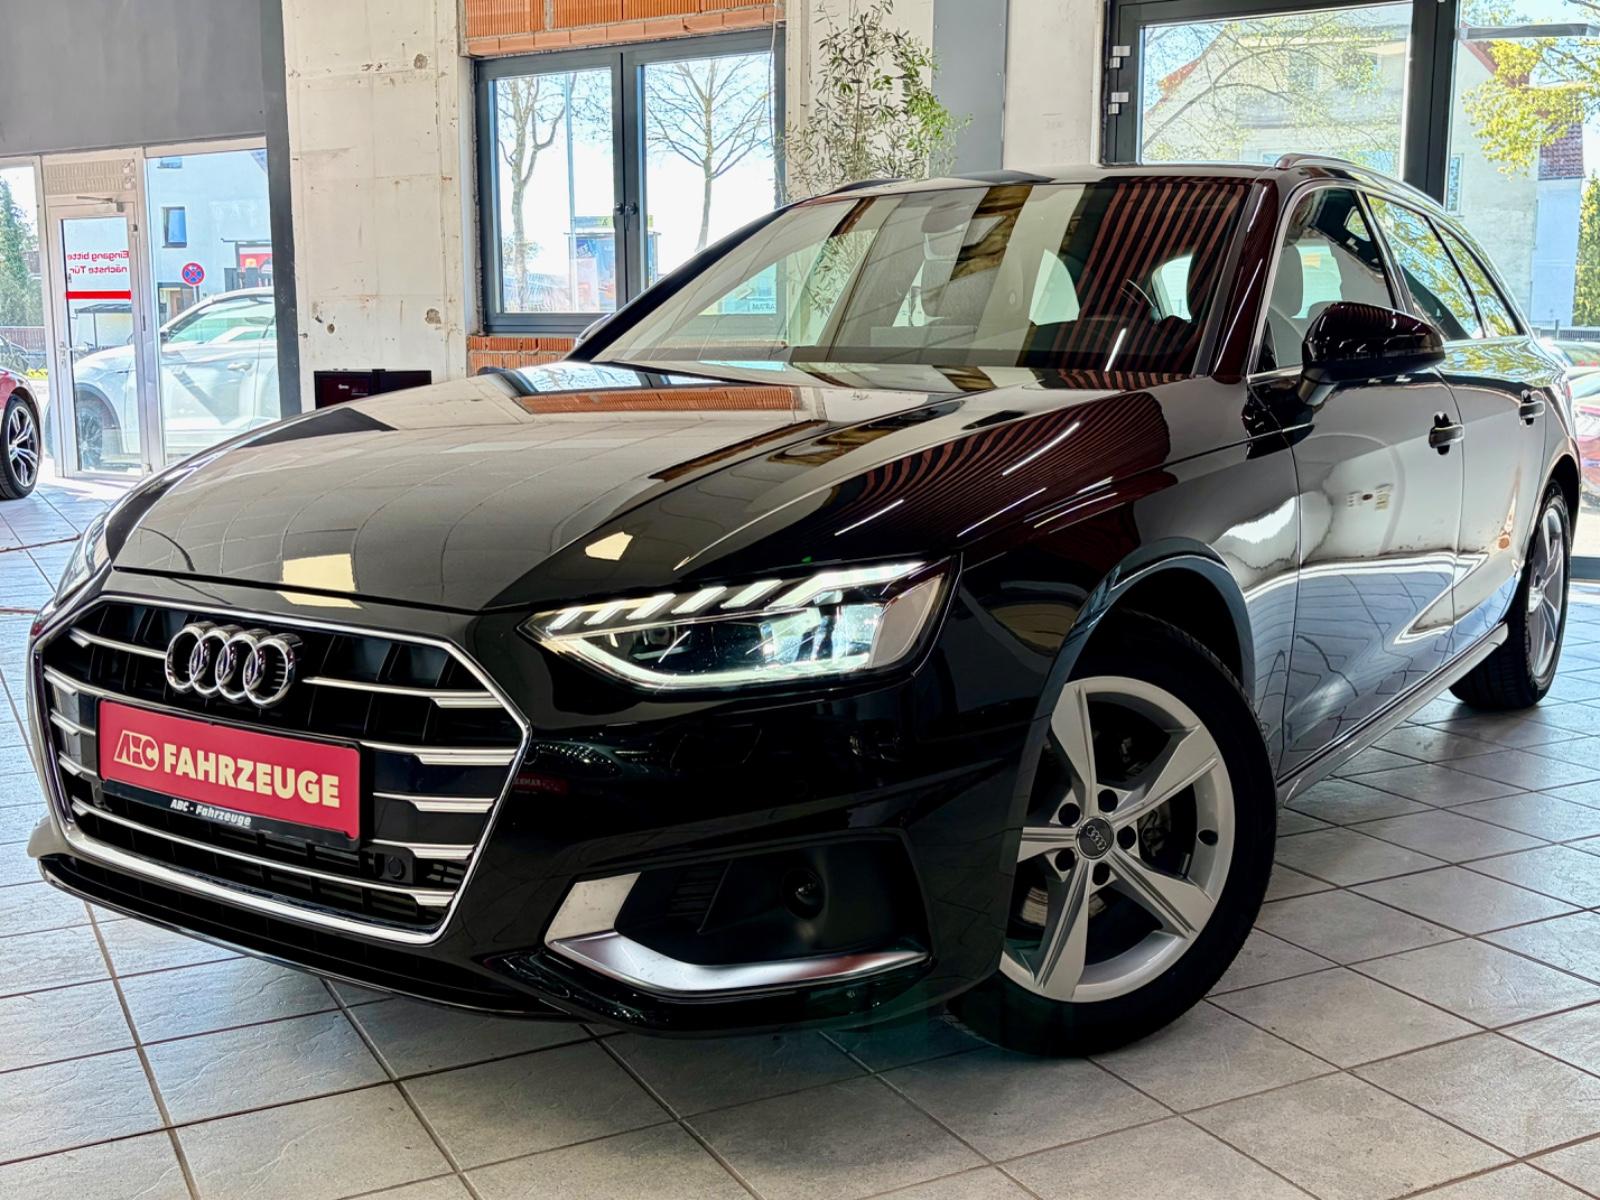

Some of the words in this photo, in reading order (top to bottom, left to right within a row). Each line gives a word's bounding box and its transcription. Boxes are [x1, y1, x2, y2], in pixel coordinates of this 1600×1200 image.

[163, 743, 340, 808] FAHRZEUGE
[170, 799, 190, 812] ABC
[195, 804, 252, 826] Fahrzeuge
